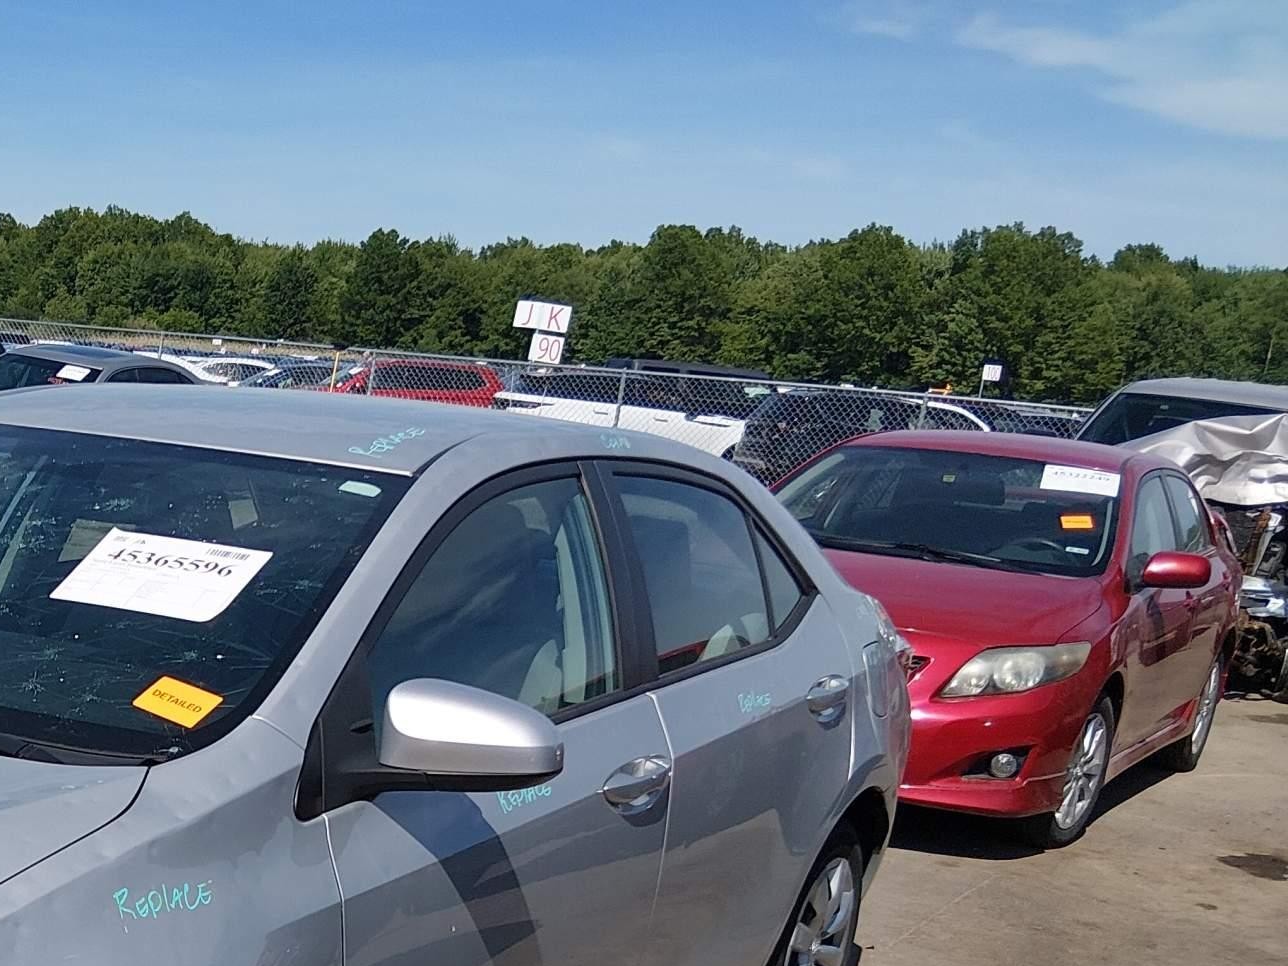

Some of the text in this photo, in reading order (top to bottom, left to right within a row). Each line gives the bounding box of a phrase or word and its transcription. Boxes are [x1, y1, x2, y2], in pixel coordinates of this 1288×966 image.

[521, 303, 565, 331] J K
[537, 337, 561, 361] 90
[107, 548, 238, 577] 45365596
[152, 688, 203, 713] DETAILED
